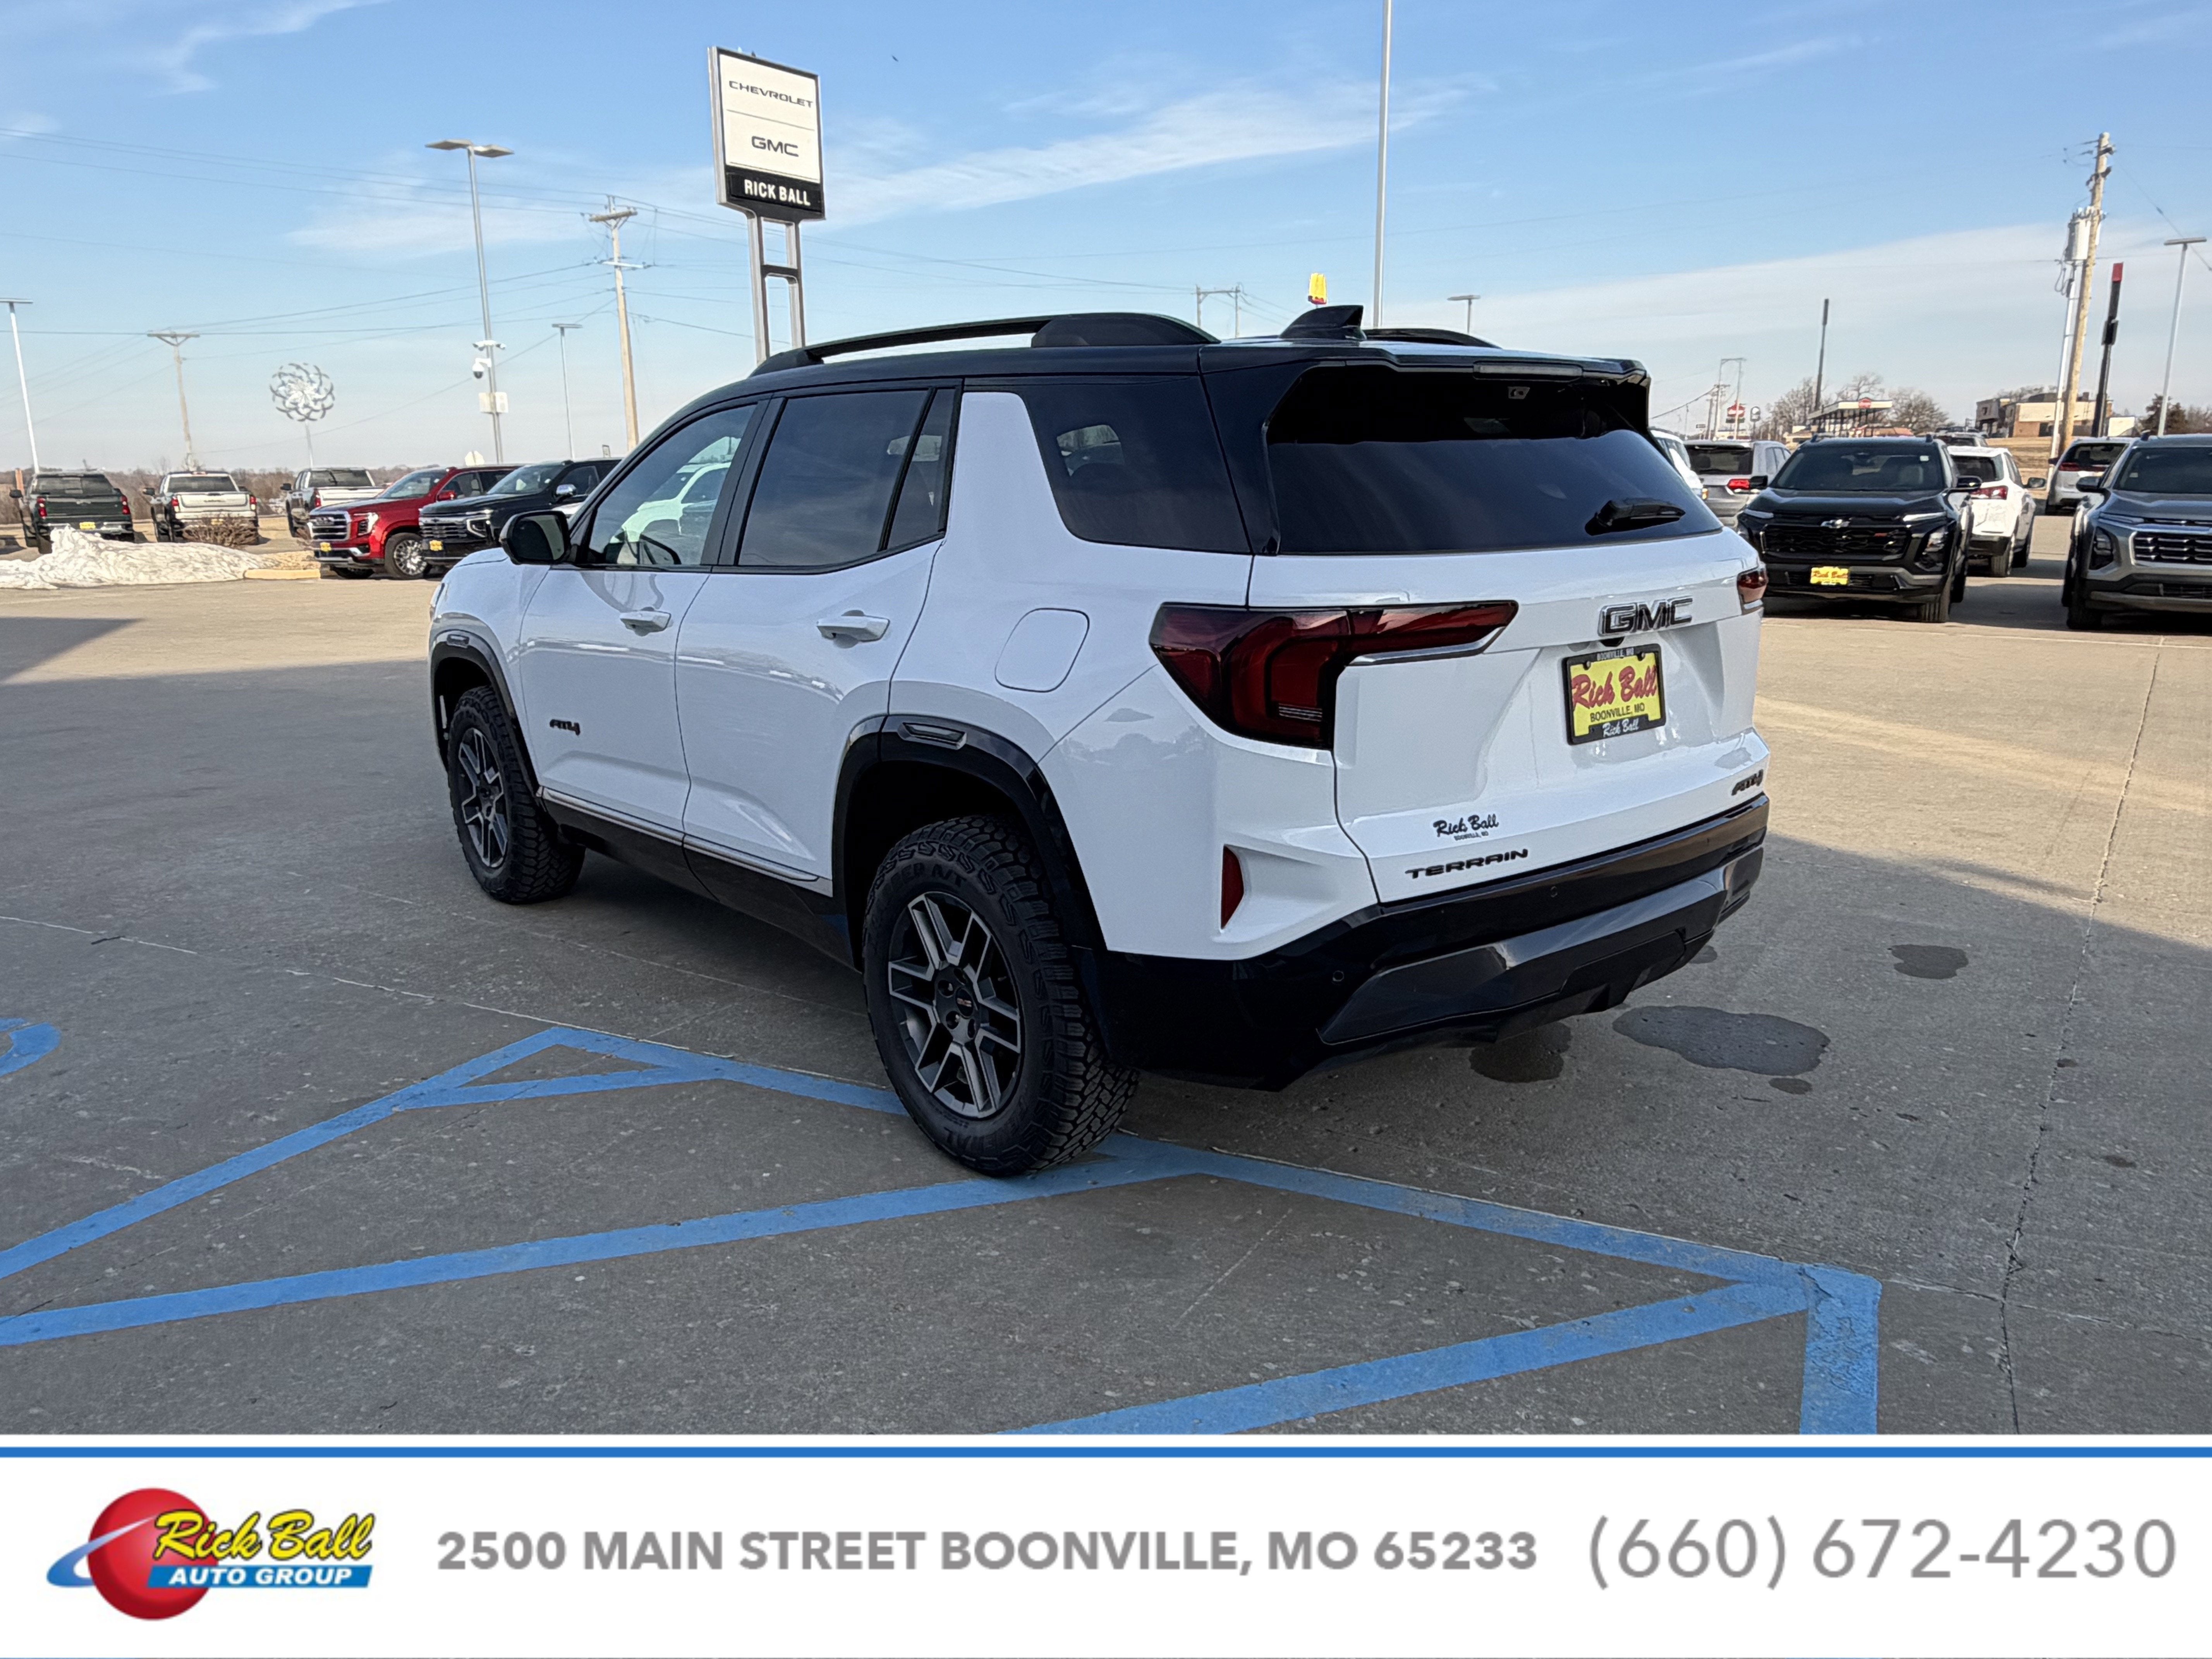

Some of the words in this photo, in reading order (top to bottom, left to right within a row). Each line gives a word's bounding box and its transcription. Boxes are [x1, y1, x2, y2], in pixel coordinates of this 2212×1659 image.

[729, 81, 813, 108] CHEVROLET
[752, 136, 799, 157] GMC
[744, 179, 776, 199] RICK
[779, 185, 811, 206] BALL
[1597, 595, 1693, 637] GMC
[1571, 671, 1615, 711] Rick
[1619, 665, 1657, 702] Ball
[1634, 702, 1645, 713] MO
[1602, 721, 1621, 737] Rick
[1622, 718, 1640, 732] Ball
[1433, 817, 1468, 838] Rick
[1468, 814, 1499, 831] Ball
[1405, 848, 1528, 879] TERRAIN
